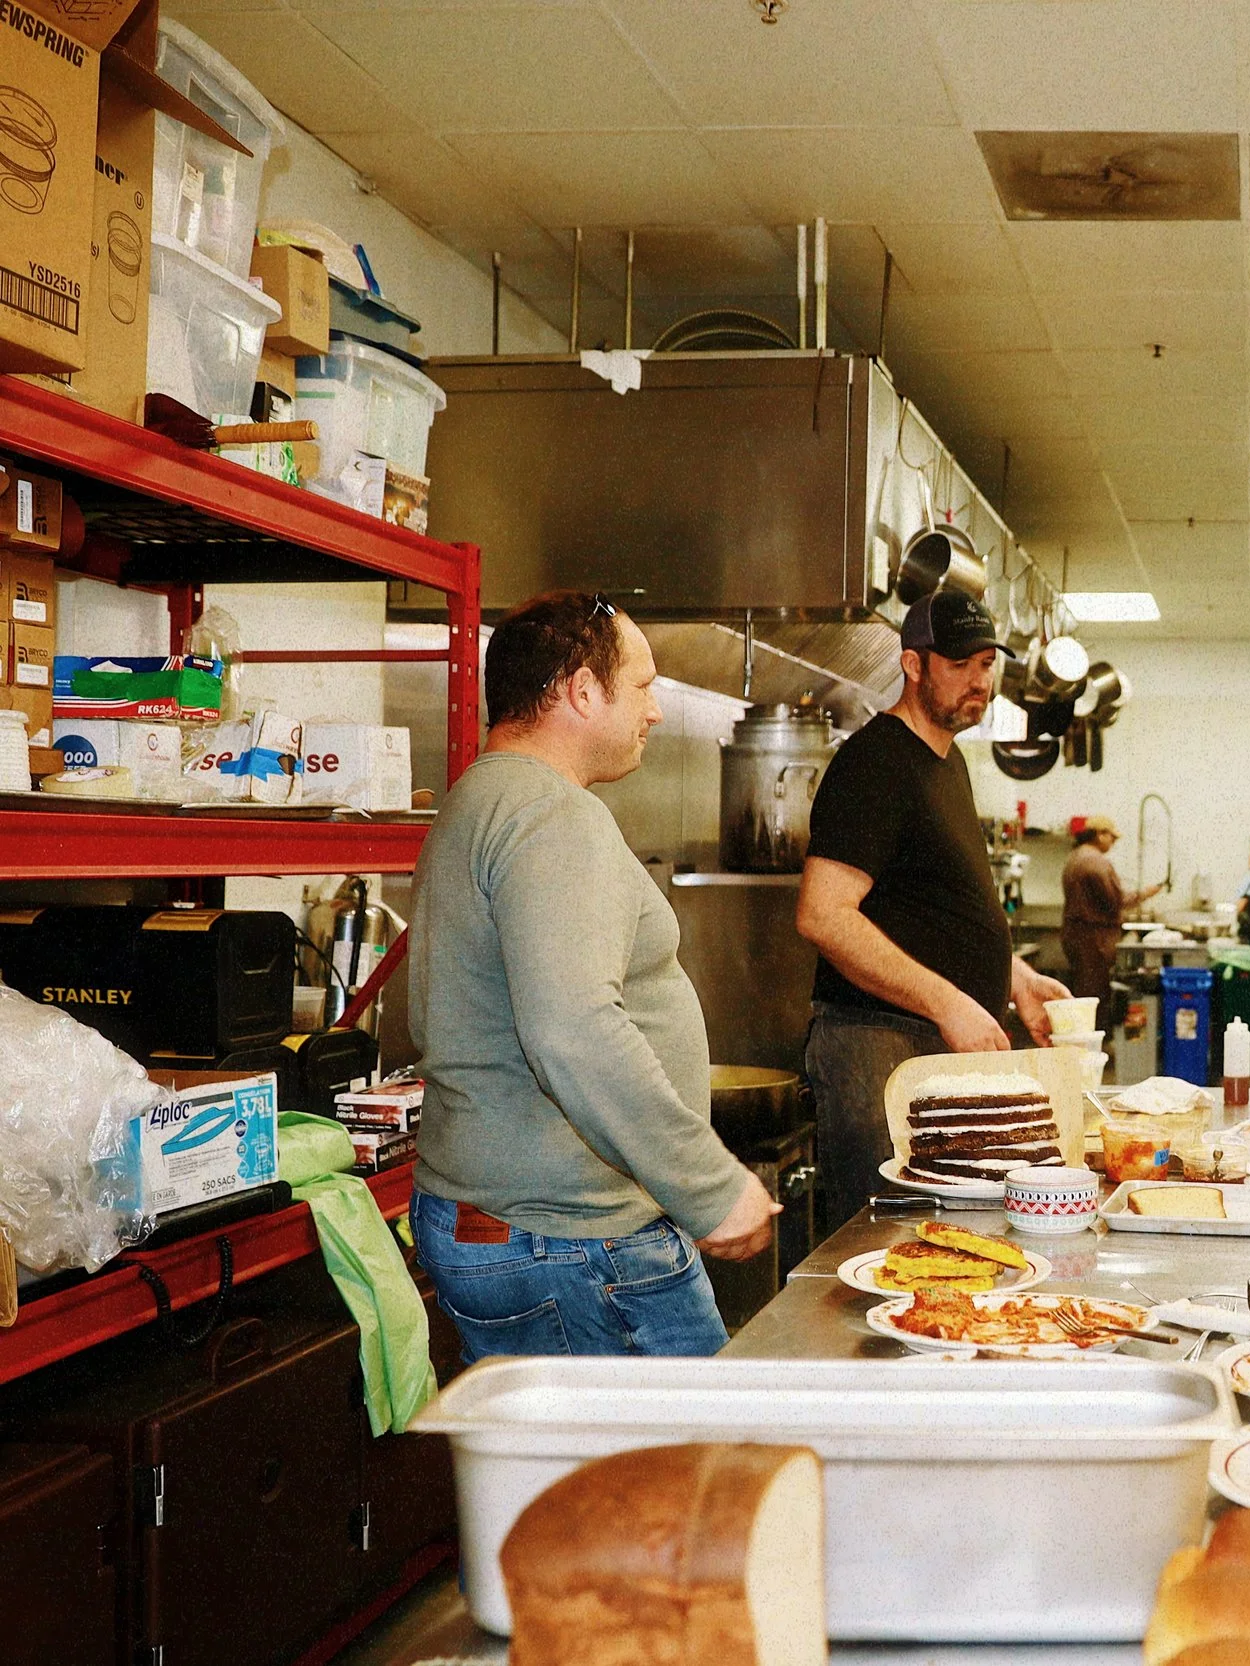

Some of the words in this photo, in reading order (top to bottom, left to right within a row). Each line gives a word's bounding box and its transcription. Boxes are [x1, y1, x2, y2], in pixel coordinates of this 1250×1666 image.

[28, 260, 81, 299] YSD2516
[138, 705, 172, 715] RK624
[306, 753, 340, 773] se
[42, 986, 133, 1005] STANLEY
[150, 1101, 190, 1130] Ziploc
[201, 1179, 216, 1191] 250
[217, 1174, 236, 1187] SACS
